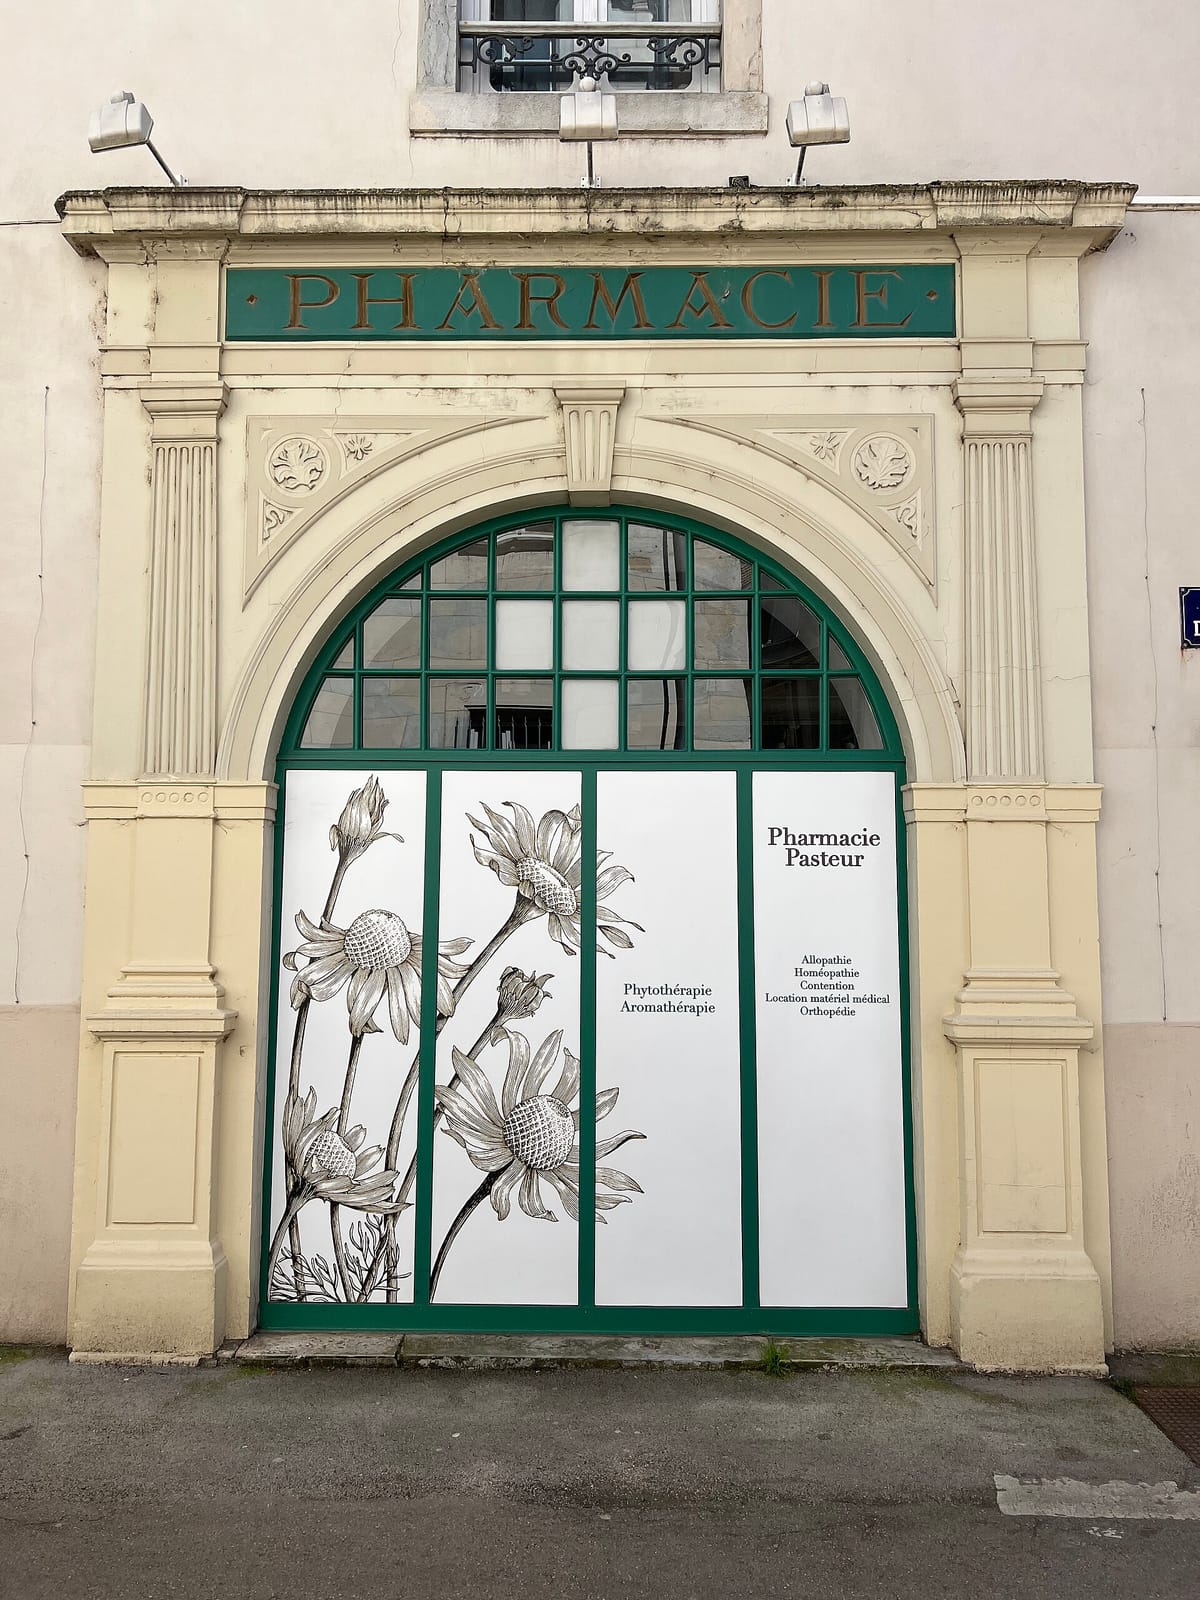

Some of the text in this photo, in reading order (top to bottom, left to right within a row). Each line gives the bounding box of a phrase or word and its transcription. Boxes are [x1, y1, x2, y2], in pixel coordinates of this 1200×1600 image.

[282, 270, 912, 331] PHARMACIE
[768, 827, 881, 846] Pharmacie
[785, 848, 864, 867] Pasteur
[801, 954, 852, 967] Allopathie
[794, 967, 860, 980] Homéopathie
[624, 983, 712, 999] Phytothérapie
[800, 980, 855, 990] Contention
[765, 993, 890, 1004] Location matériel médical
[620, 1000, 716, 1017] Aromathérapie
[800, 1006, 856, 1018] Orthopédie
